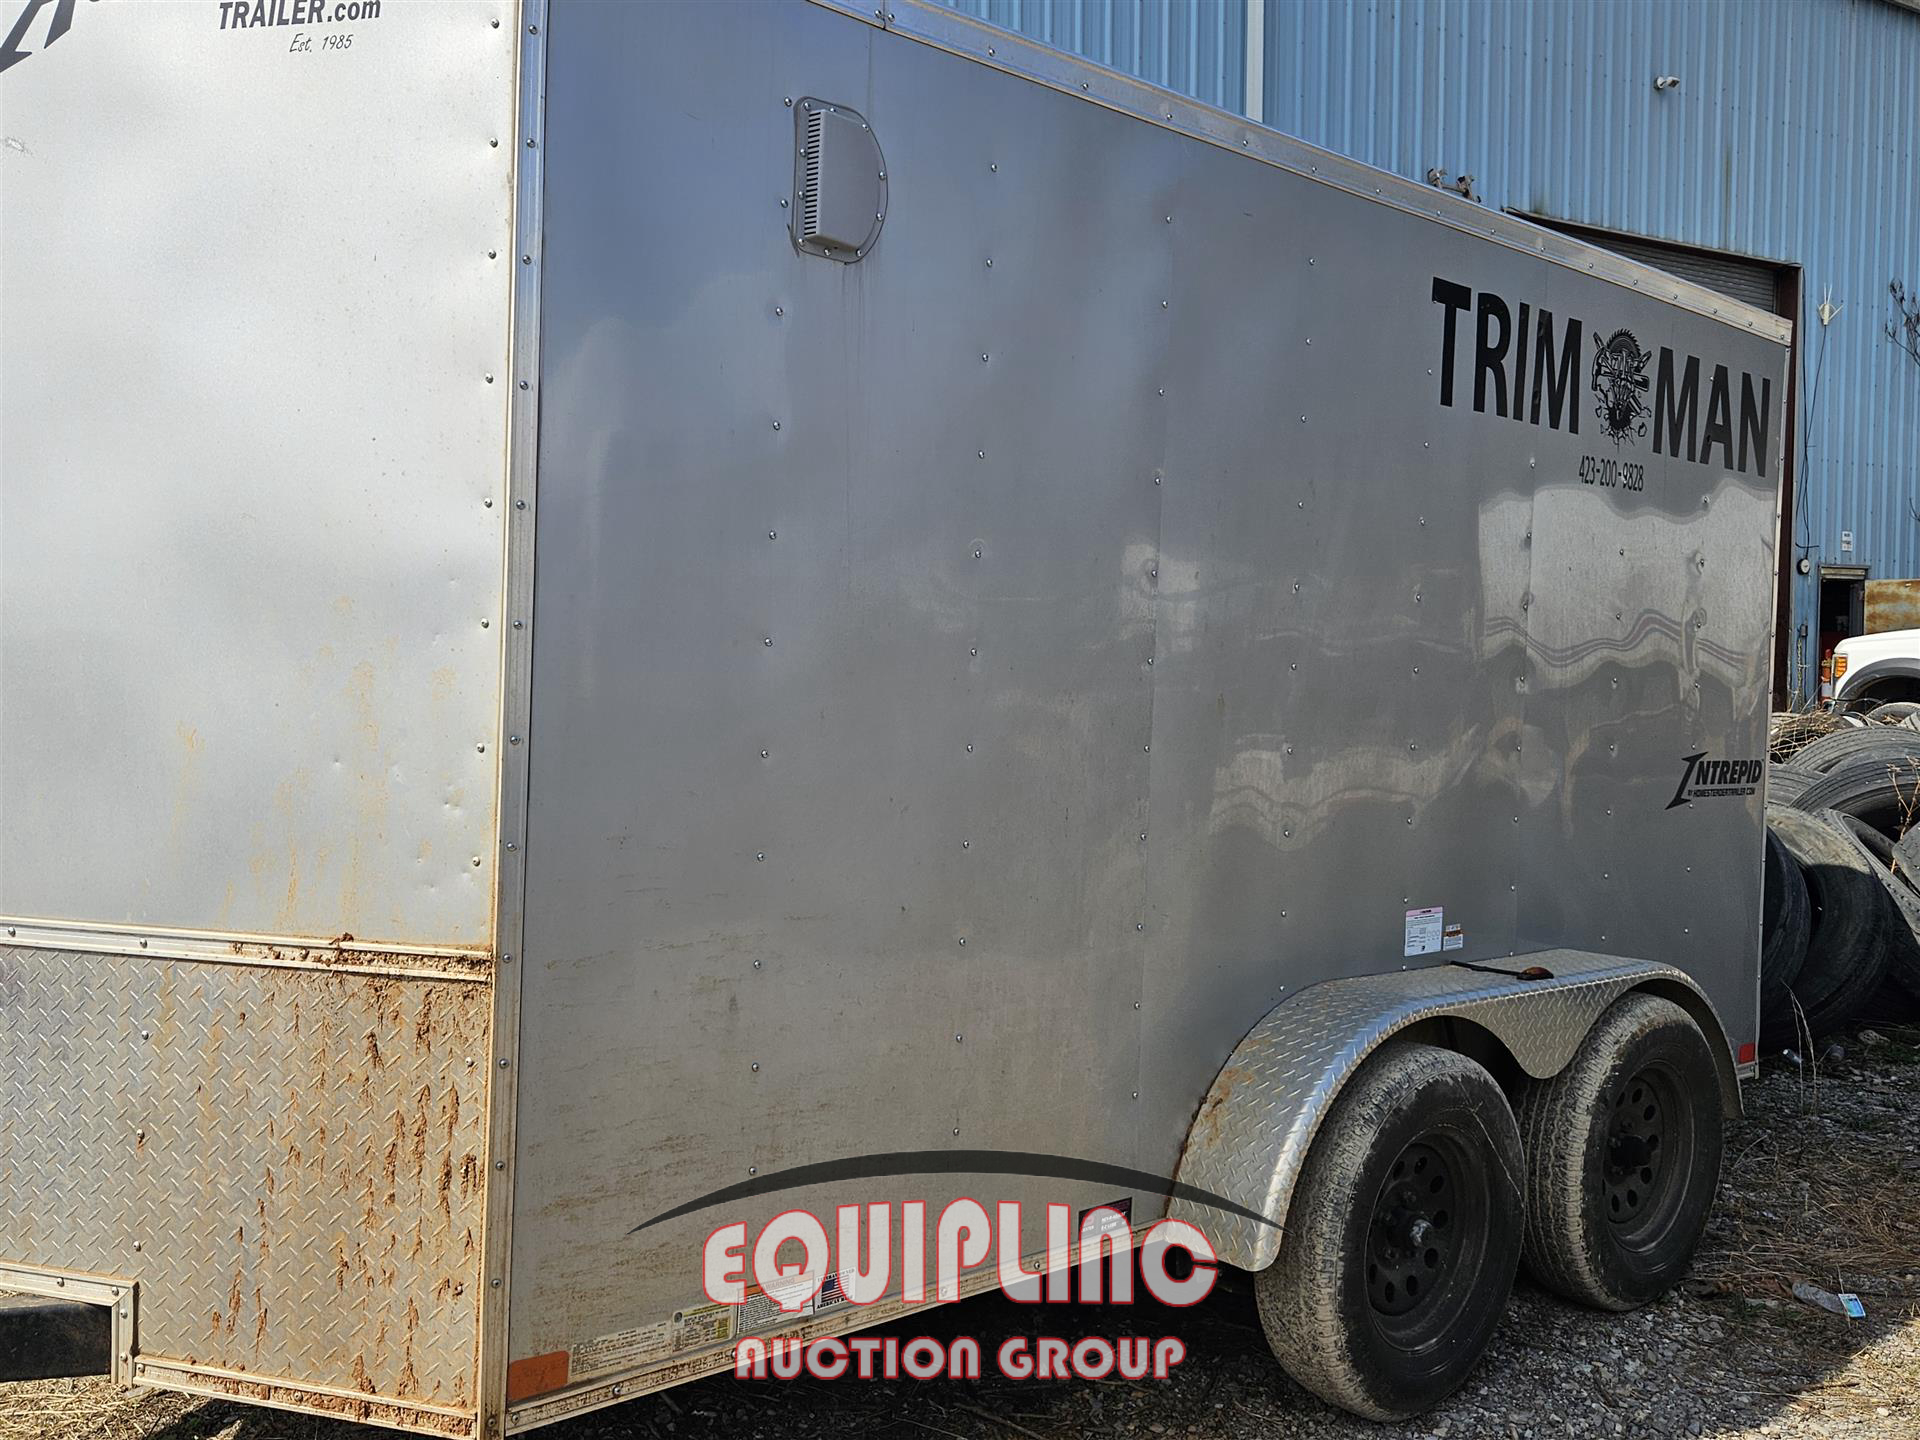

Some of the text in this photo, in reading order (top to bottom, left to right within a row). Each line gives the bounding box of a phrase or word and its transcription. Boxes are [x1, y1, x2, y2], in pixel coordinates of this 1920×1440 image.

[218, 0, 381, 29] TRAILER.com
[289, 33, 354, 53] Est. 1985
[1431, 276, 1771, 478] TRIM MAN
[1578, 455, 1644, 492] 423-200-9828
[1664, 751, 1763, 810] INTREPID
